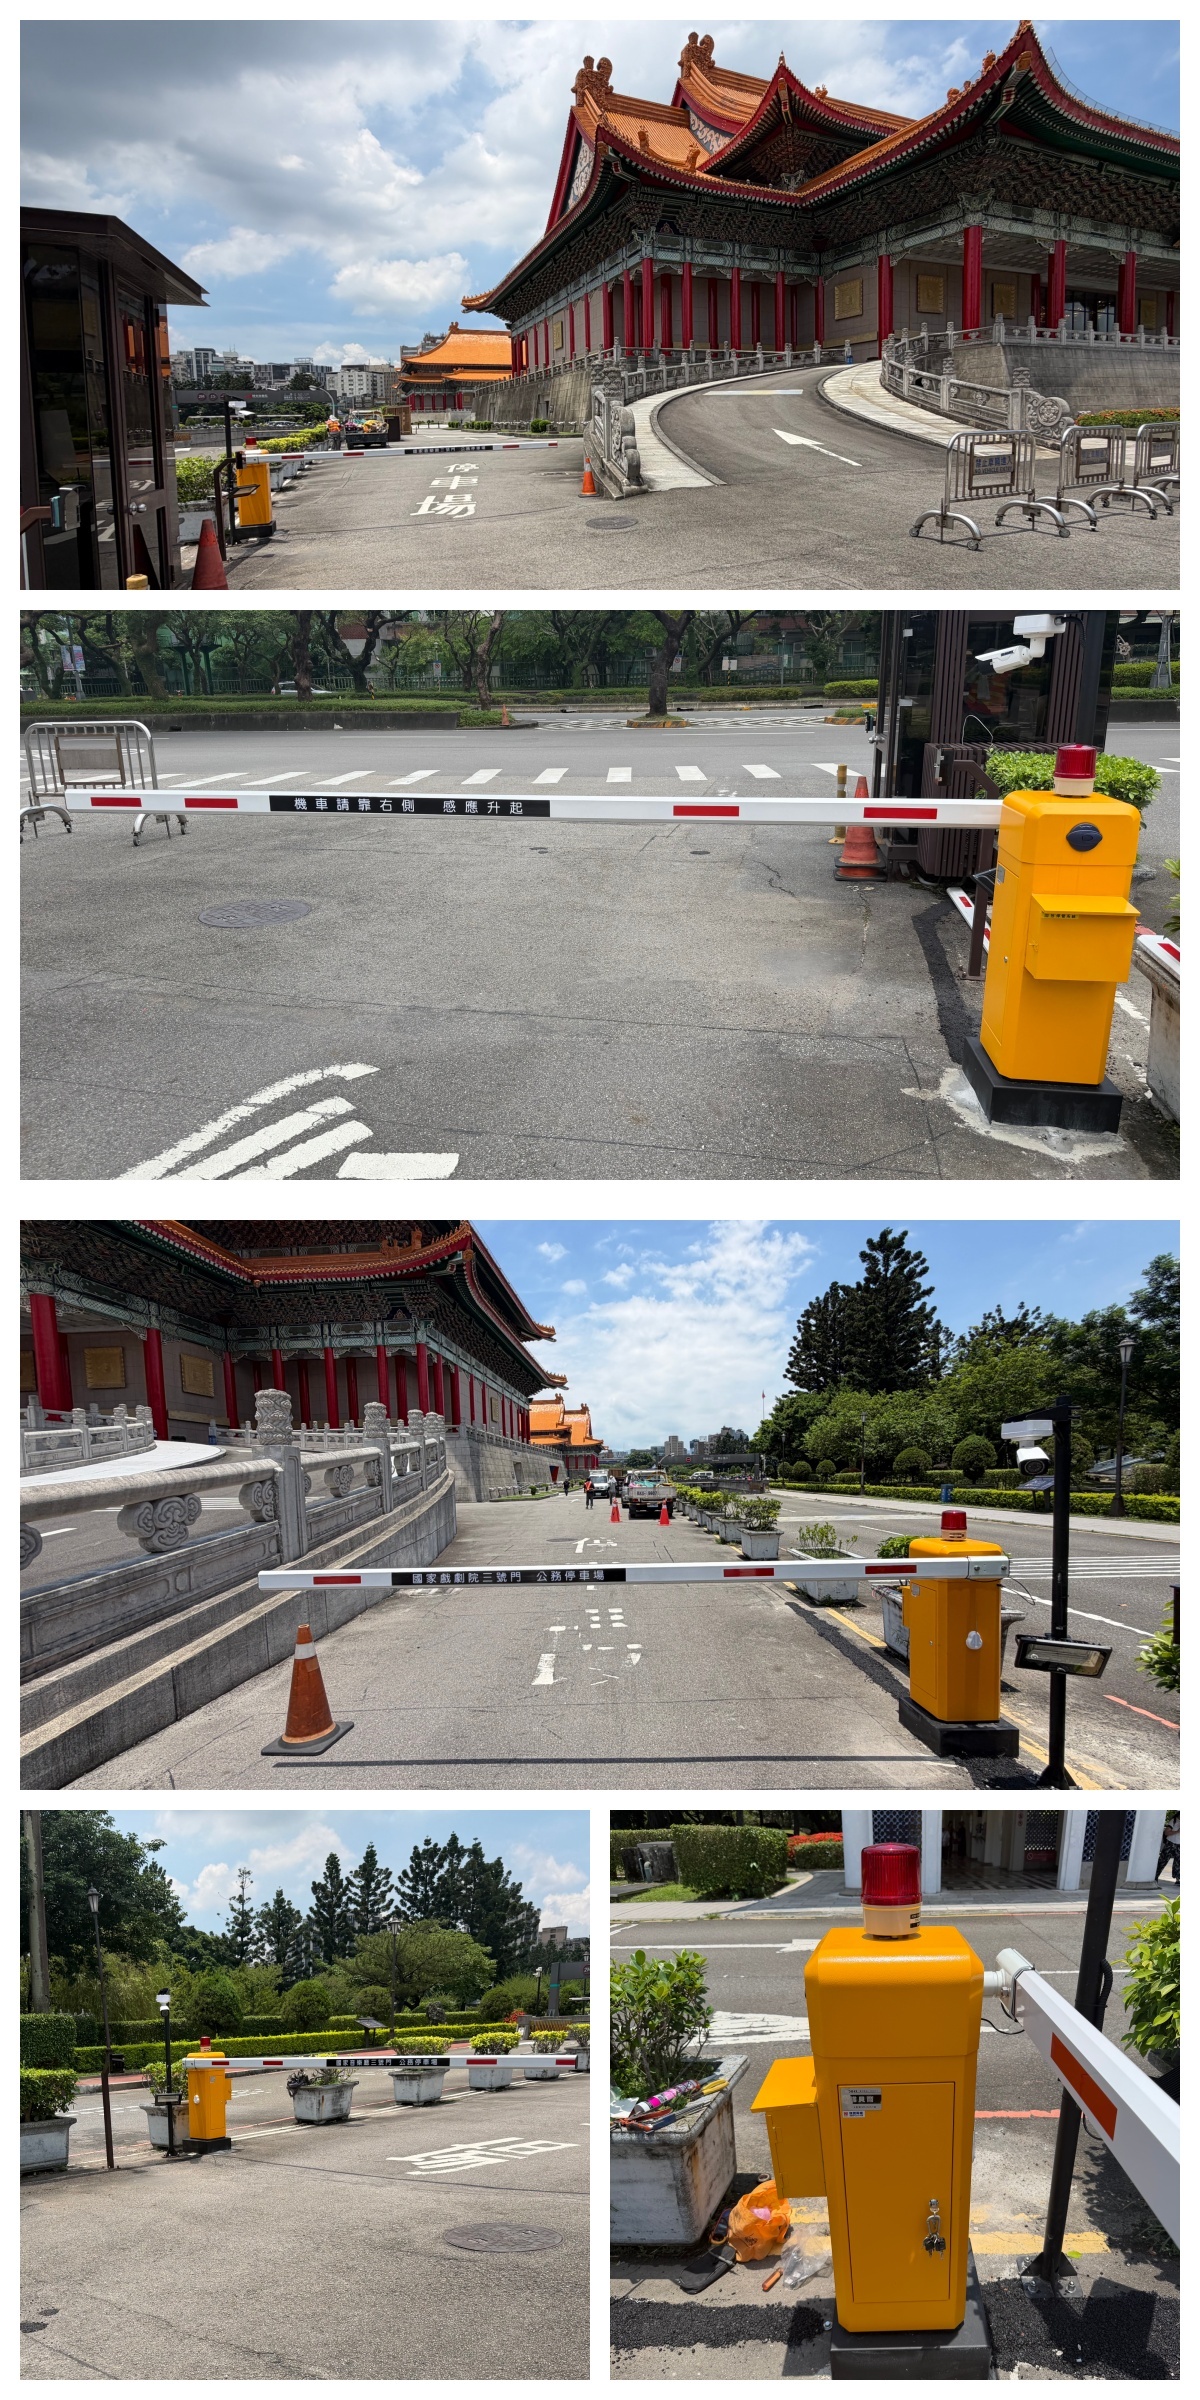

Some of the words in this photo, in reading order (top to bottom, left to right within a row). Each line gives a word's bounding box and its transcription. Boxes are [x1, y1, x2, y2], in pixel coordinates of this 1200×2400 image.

[410, 463, 479, 519] 停車場
[294, 798, 415, 813] 機車請靠右側
[443, 801, 523, 815] 感應升起
[412, 1572, 521, 1584] 國家戲劇院三號門
[536, 1570, 604, 1581] 公務停車場
